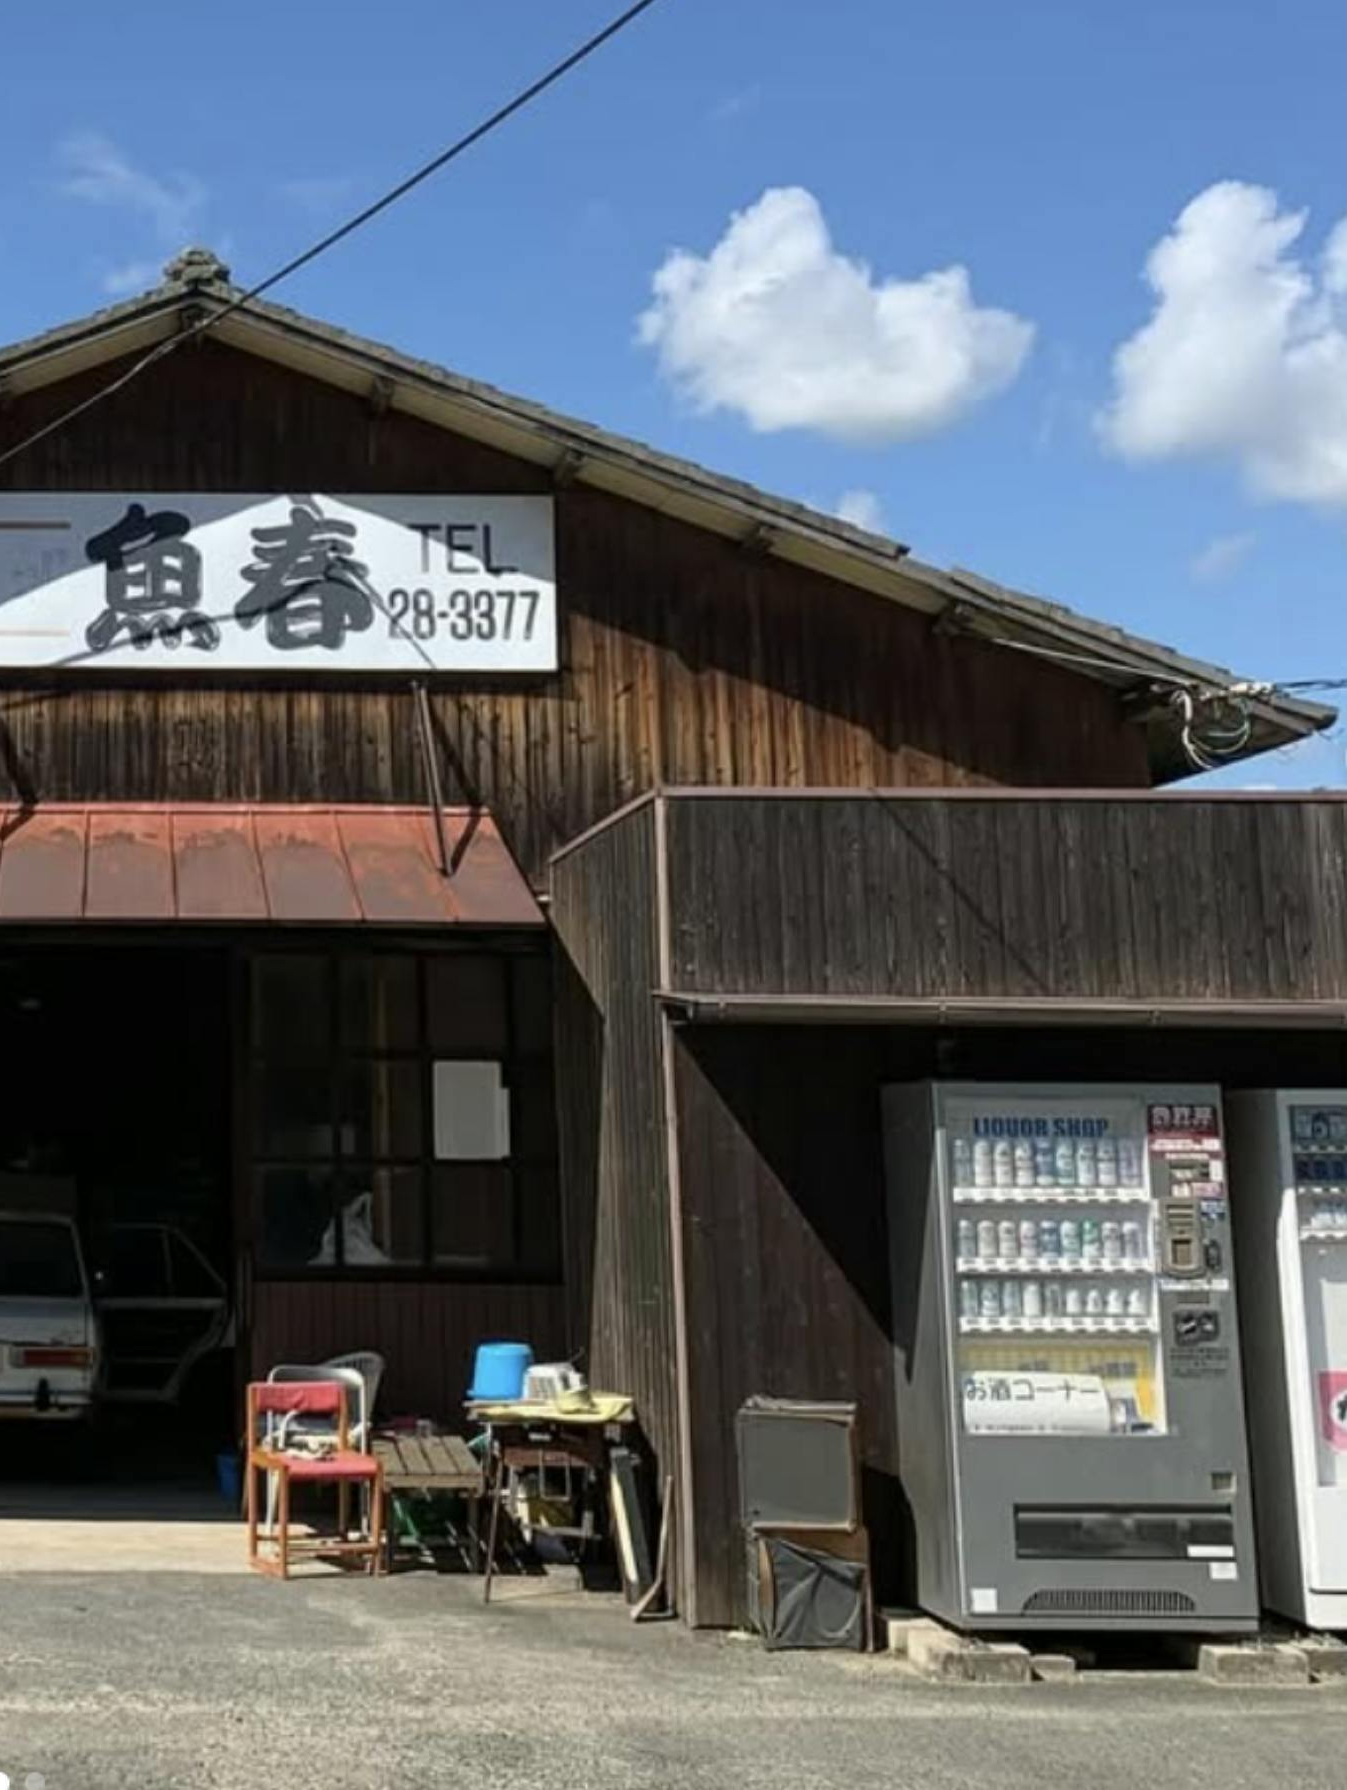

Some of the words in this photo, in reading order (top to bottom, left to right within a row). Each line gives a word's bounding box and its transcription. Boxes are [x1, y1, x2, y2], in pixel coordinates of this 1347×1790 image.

[407, 523, 519, 574] TEL
[85, 503, 374, 650] 魚春
[388, 587, 540, 641] 28-3377
[973, 1116, 1048, 1137] LIQUOR
[1053, 1116, 1109, 1137] SHOP
[964, 1377, 1100, 1401] お酒コーナー
